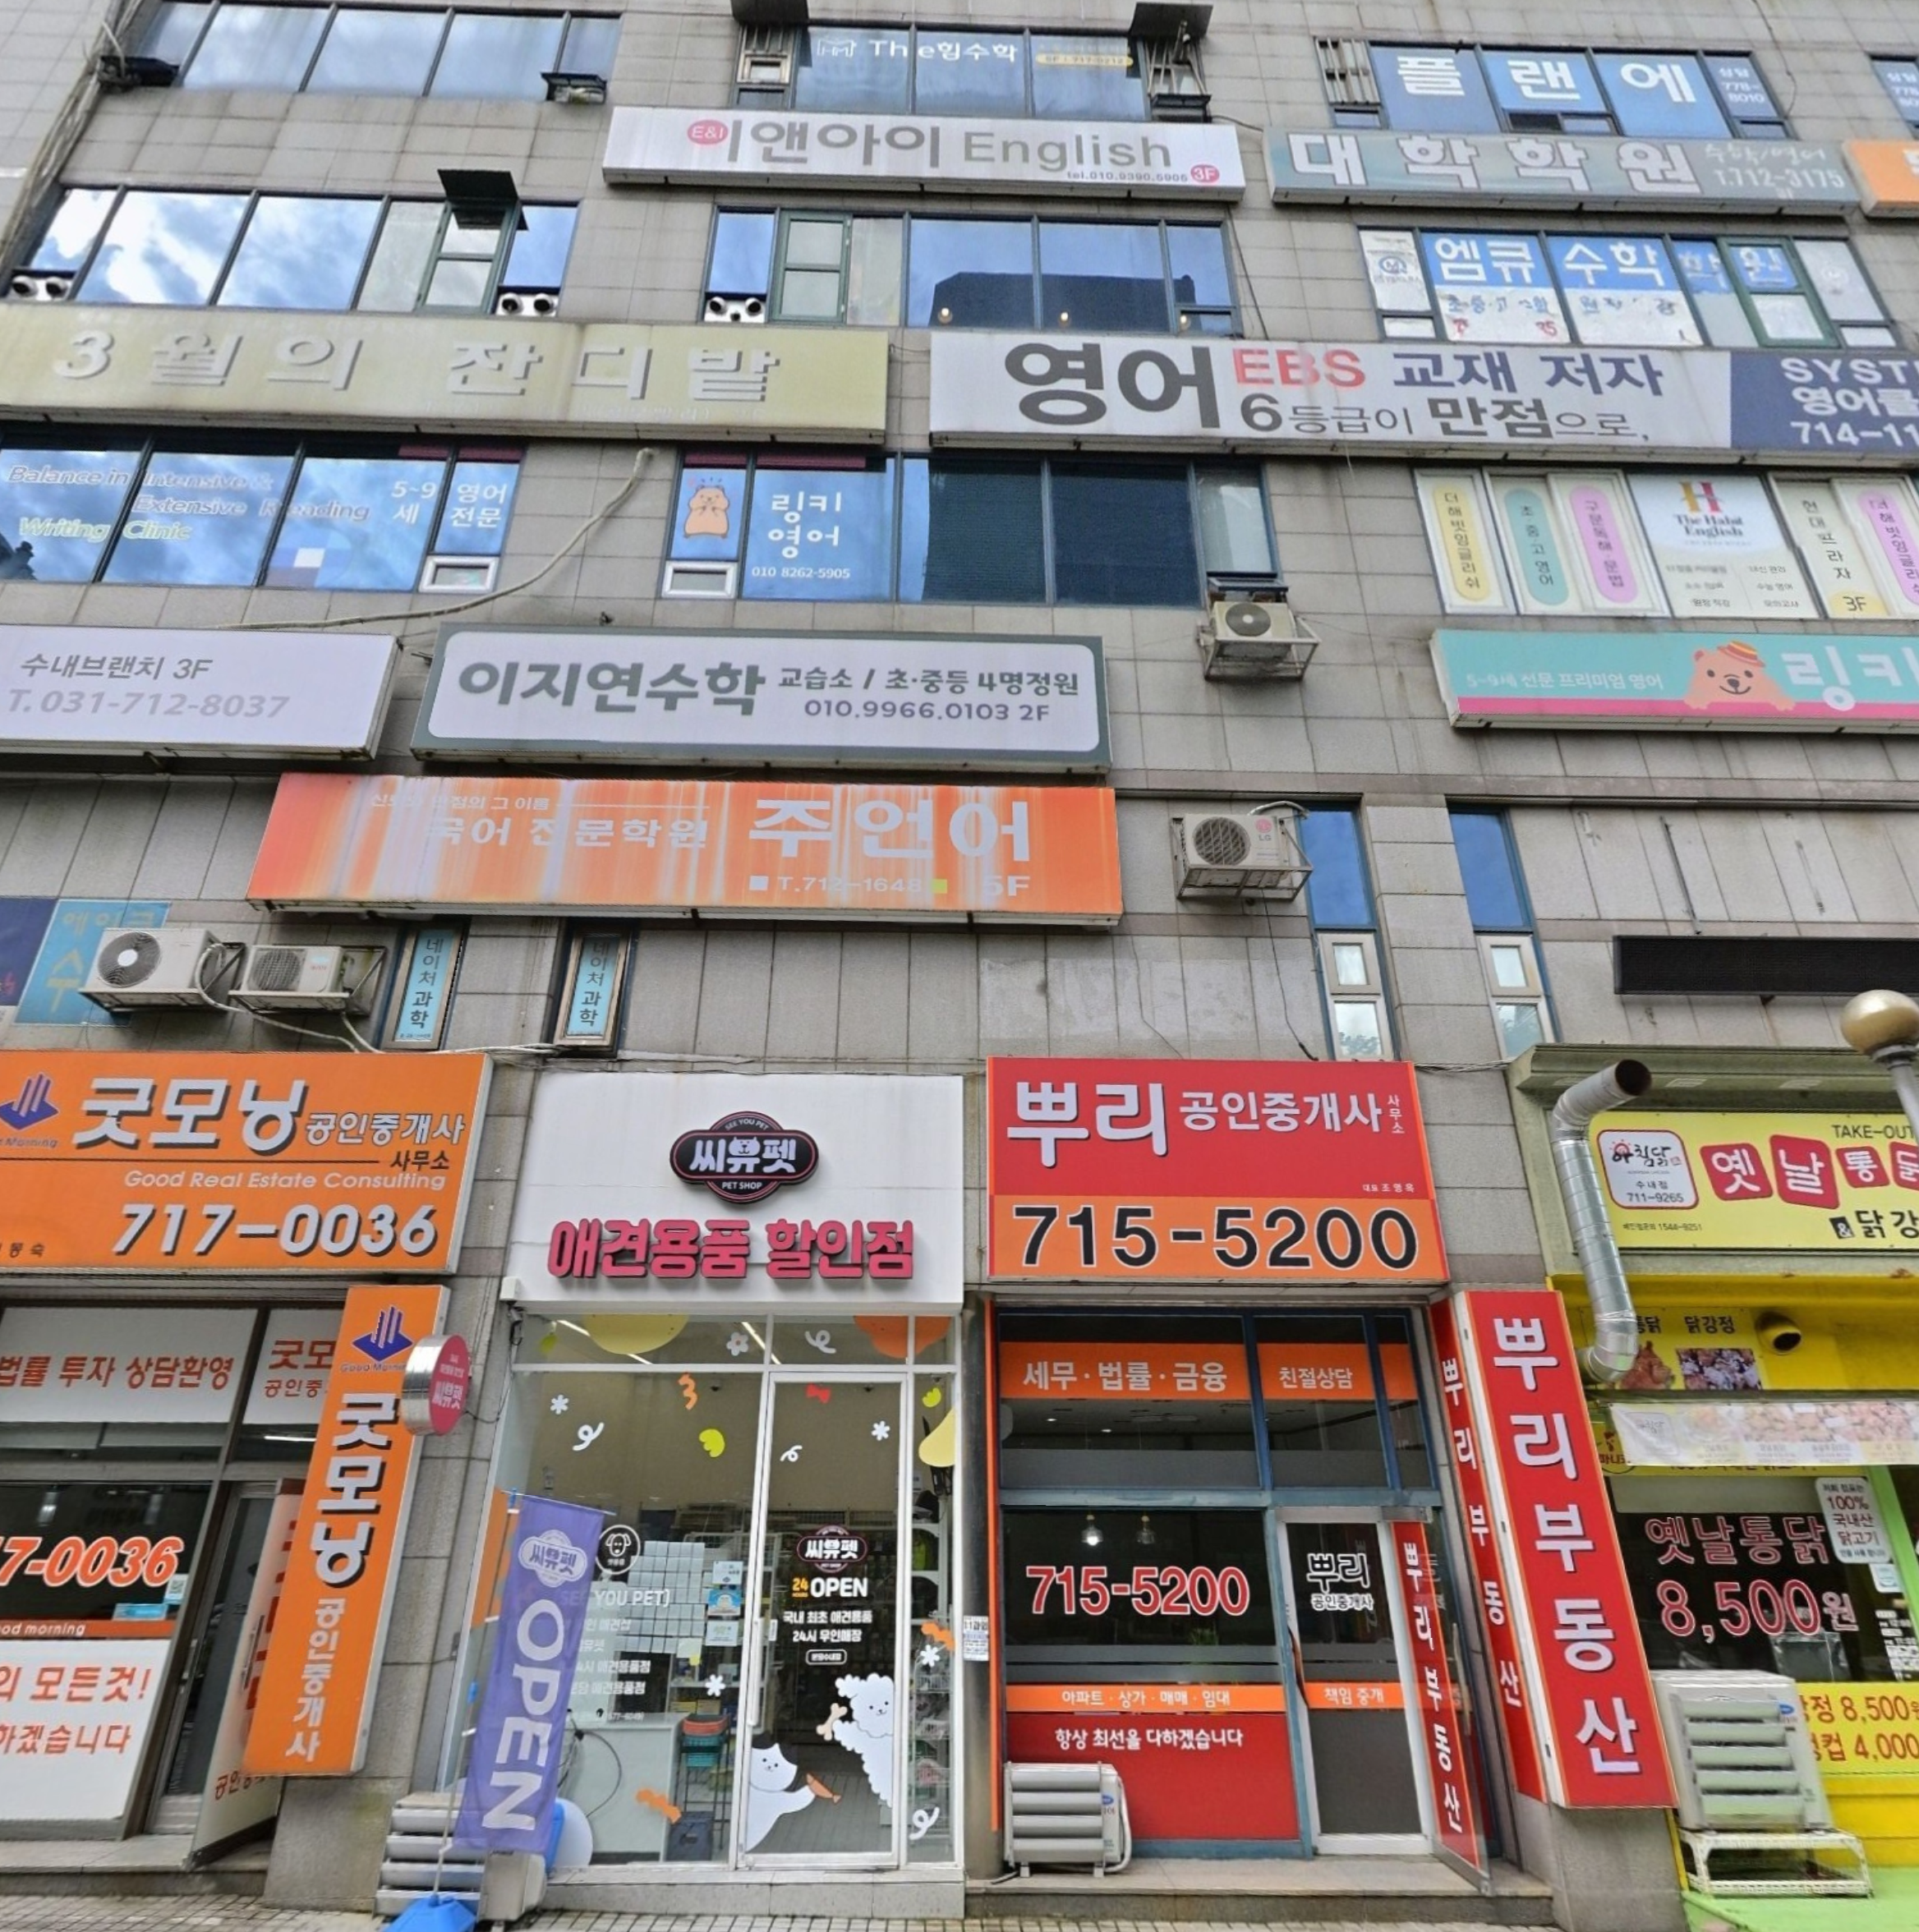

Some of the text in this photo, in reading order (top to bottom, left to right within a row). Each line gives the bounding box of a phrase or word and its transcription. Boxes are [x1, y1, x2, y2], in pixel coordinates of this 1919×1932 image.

[964, 131, 1172, 172] English
[1287, 133, 1703, 195] 대학학원
[1192, 166, 1219, 181] 3F
[1435, 237, 1665, 287] 엠큐 수학
[1004, 342, 1221, 429] 영어
[1234, 347, 1664, 397] EBS 교재 저자
[1240, 393, 1650, 443] 6등급이 만점으로,
[9, 465, 102, 485] Balance
[106, 467, 129, 486] in
[131, 494, 247, 516] Extensive
[457, 482, 508, 504] 영어
[393, 503, 421, 525] 세
[450, 506, 502, 528] 전문
[771, 490, 842, 524] 링키
[1673, 513, 1701, 527] The
[19, 517, 193, 544] Writing Clinic
[767, 524, 840, 559] 영어
[1683, 526, 1744, 539] English
[751, 566, 777, 577] 010
[1843, 596, 1867, 612] 3F
[20, 653, 214, 680] 수내브랜치 3F
[458, 660, 766, 716] 이지연수학
[778, 666, 854, 690] 교습소
[977, 670, 1080, 697] 4명정원
[1558, 672, 1664, 691] 프리미엄 영어
[7, 688, 291, 719] T.031-712-8037
[803, 699, 1050, 722] 010.9966.0103 2F
[514, 796, 550, 812] 이름
[748, 798, 1031, 862] 주언어
[71, 1077, 467, 1157] 굿모닝 공인중개사
[1006, 1080, 1383, 1169] 뿌리 공인중개사
[1386, 1092, 1406, 1135] 사무소
[389, 1150, 450, 1172] 사무소
[125, 1170, 447, 1191] Good Real Estate Consulting
[721, 1180, 763, 1191] PET SHOP
[112, 1203, 438, 1258] 717-0036
[1012, 1203, 1420, 1272] 715-5200
[546, 1217, 914, 1280] 애견용품 할인점
[1684, 1315, 1737, 1334] 닭강정
[58, 1355, 117, 1388] 투자
[126, 1355, 235, 1391] 상담환영
[1278, 1366, 1355, 1391] 친절상담
[1826, 1495, 1870, 1510] 100%
[1493, 1318, 1641, 1774] 뿌리부동산
[1645, 1516, 1829, 1565] 옛날통닭
[0, 1535, 185, 1588] 7-0036
[1306, 1552, 1371, 1594] 뿌리
[792, 1576, 868, 1598] 24 OPEN
[1025, 1565, 1251, 1617] 715-5200
[1310, 1592, 1374, 1612] 공인중개사
[1656, 1579, 1861, 1644] 8,500원
[24, 1622, 85, 1636] morning
[783, 1610, 805, 1624] 국내
[807, 1610, 829, 1624] 최초
[792, 1628, 863, 1643] 24시 무인매장
[30, 1666, 152, 1704] 모든것!
[285, 1597, 347, 1763] 공인중개사
[1061, 1690, 1231, 1709] 아파트 상가 매매 임대
[1323, 1686, 1384, 1704] 책임 중개
[481, 1598, 564, 1831] OPEN
[1055, 1727, 1245, 1750] 항상 최선을 다하겠습니다
